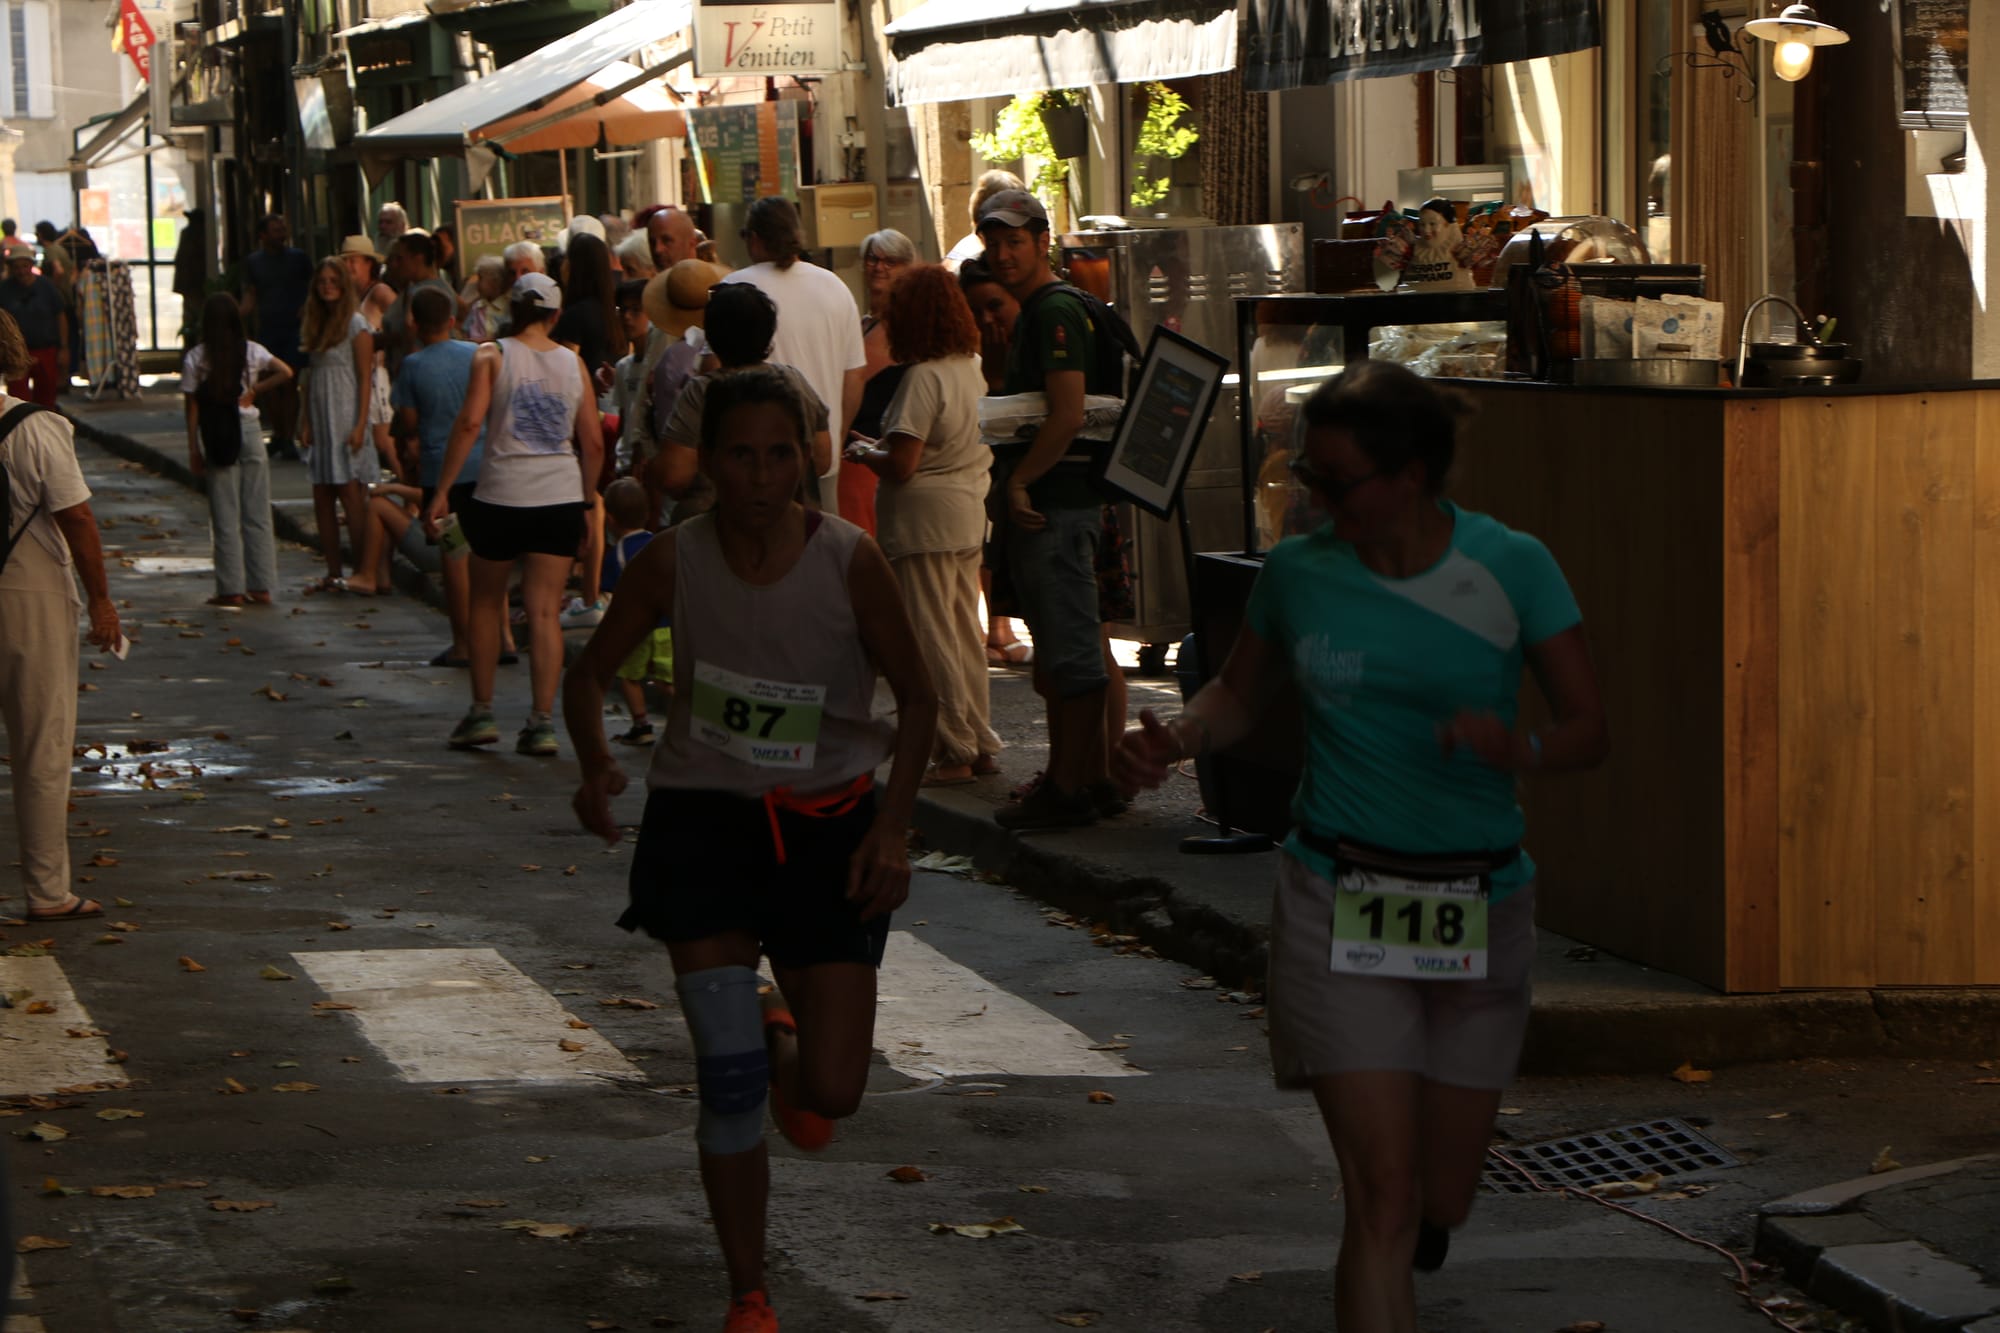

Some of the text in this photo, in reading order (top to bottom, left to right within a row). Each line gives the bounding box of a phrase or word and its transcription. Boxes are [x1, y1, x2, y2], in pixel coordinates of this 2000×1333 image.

[125, 12, 149, 69] TABAC
[723, 21, 816, 68] Vénitien
[752, 8, 815, 37] Le Petit
[723, 697, 787, 739] 87
[1359, 896, 1465, 946] 118
